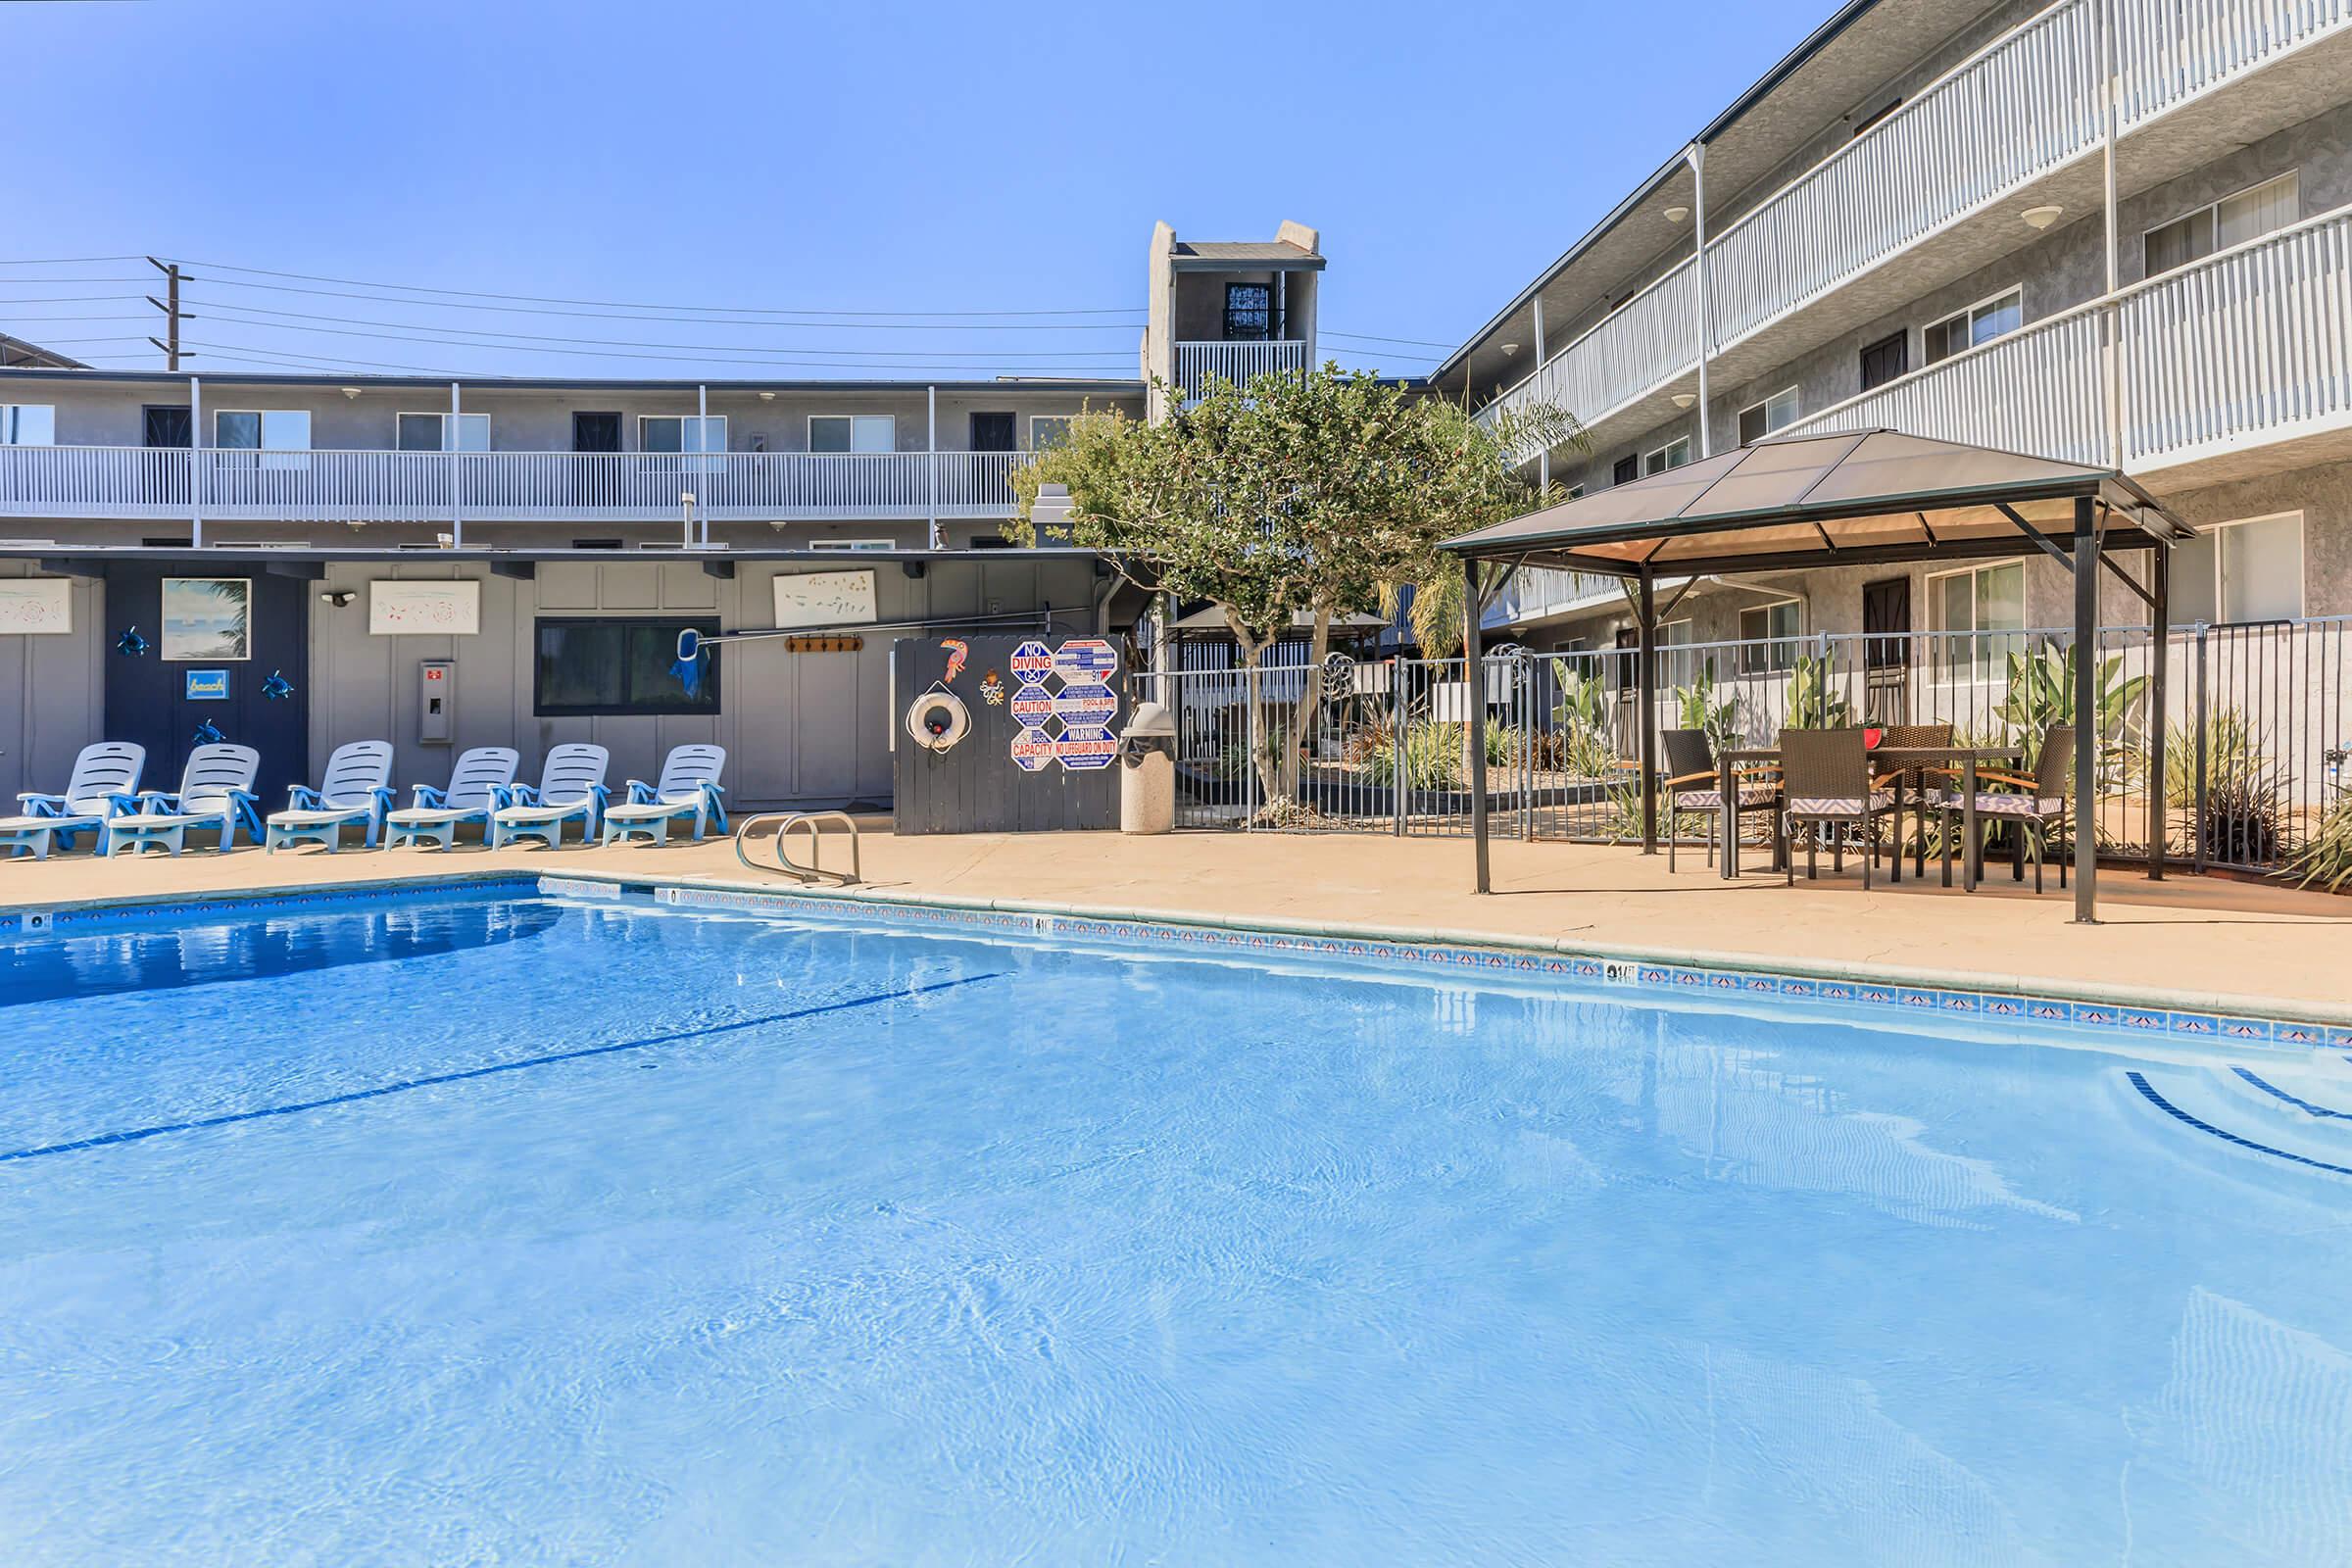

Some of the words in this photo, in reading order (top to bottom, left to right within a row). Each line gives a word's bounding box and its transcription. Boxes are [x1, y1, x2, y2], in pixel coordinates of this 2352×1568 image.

[1025, 645, 1041, 656] NO
[1012, 657, 1052, 669] DIVING
[1092, 670, 1102, 682] 911
[189, 678, 223, 691] beach
[1012, 701, 1052, 713] CAUTION
[1068, 727, 1104, 741] WARNING
[1012, 743, 1053, 757] CAPACITY
[1055, 743, 1064, 755] NO
[1064, 742, 1093, 755] LIFEGUARD
[1093, 742, 1102, 754] ON
[1102, 741, 1116, 754] DUTY
